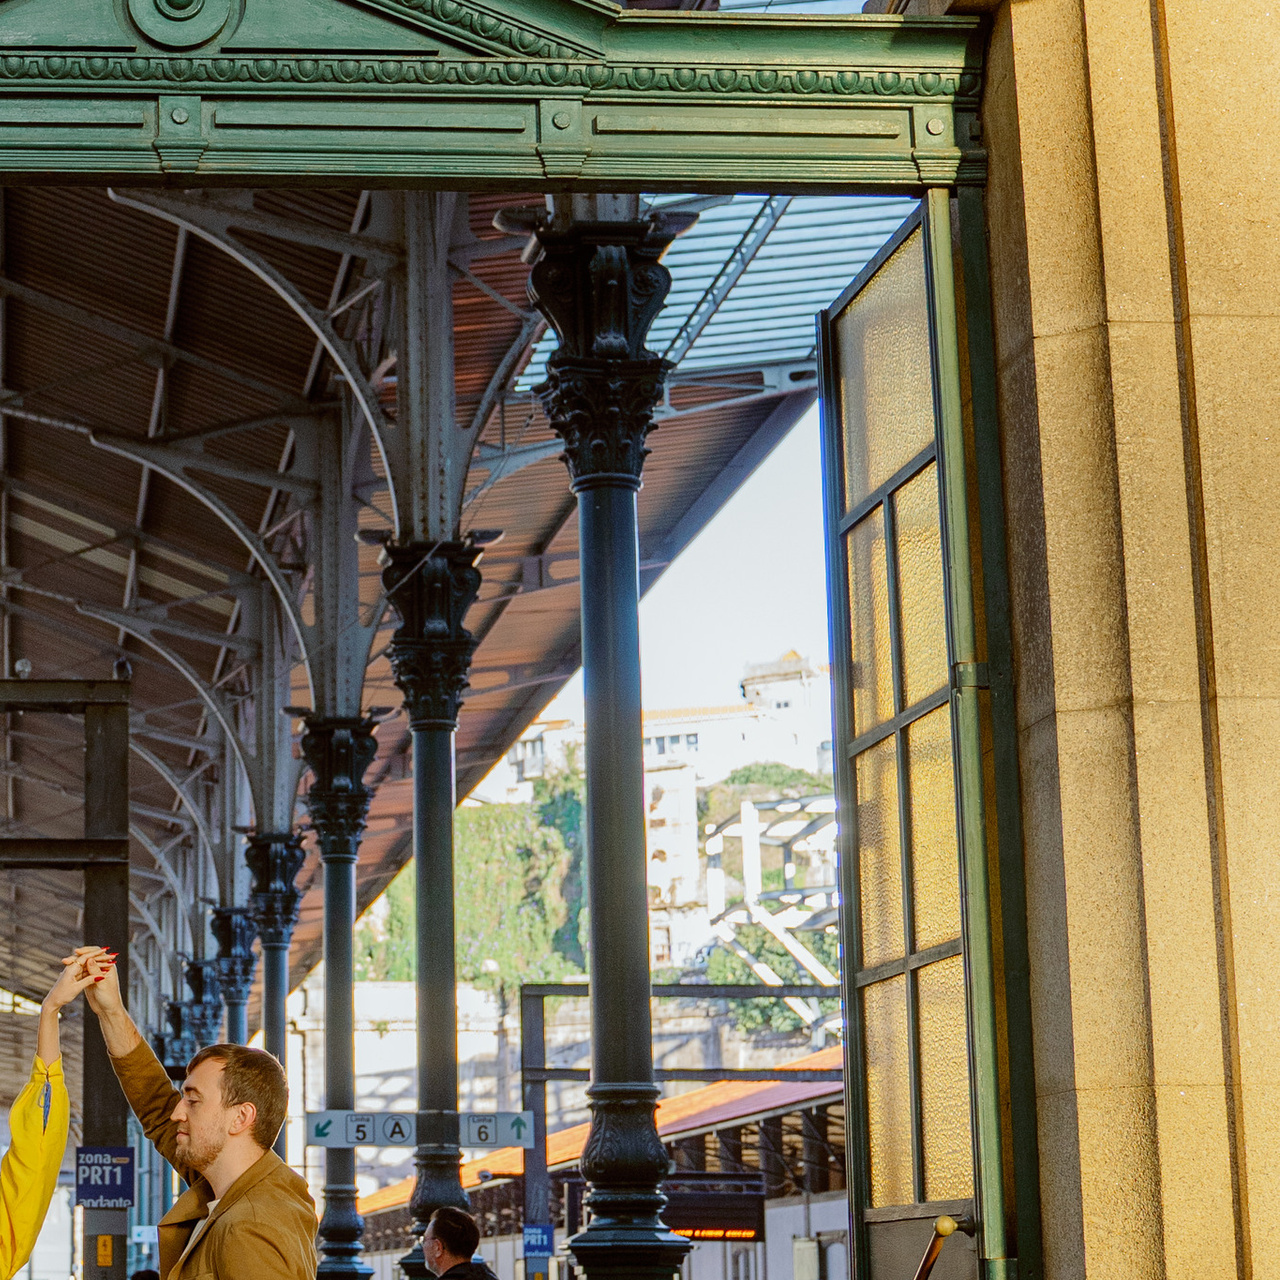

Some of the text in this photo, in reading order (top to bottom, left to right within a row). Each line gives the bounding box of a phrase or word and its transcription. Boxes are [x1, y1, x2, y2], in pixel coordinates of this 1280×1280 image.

[355, 1121, 406, 1141] 5 A
[477, 1125, 489, 1142] 6
[78, 1153, 112, 1164] zona
[78, 1165, 122, 1186] PRT1
[78, 1195, 133, 1208] andante
